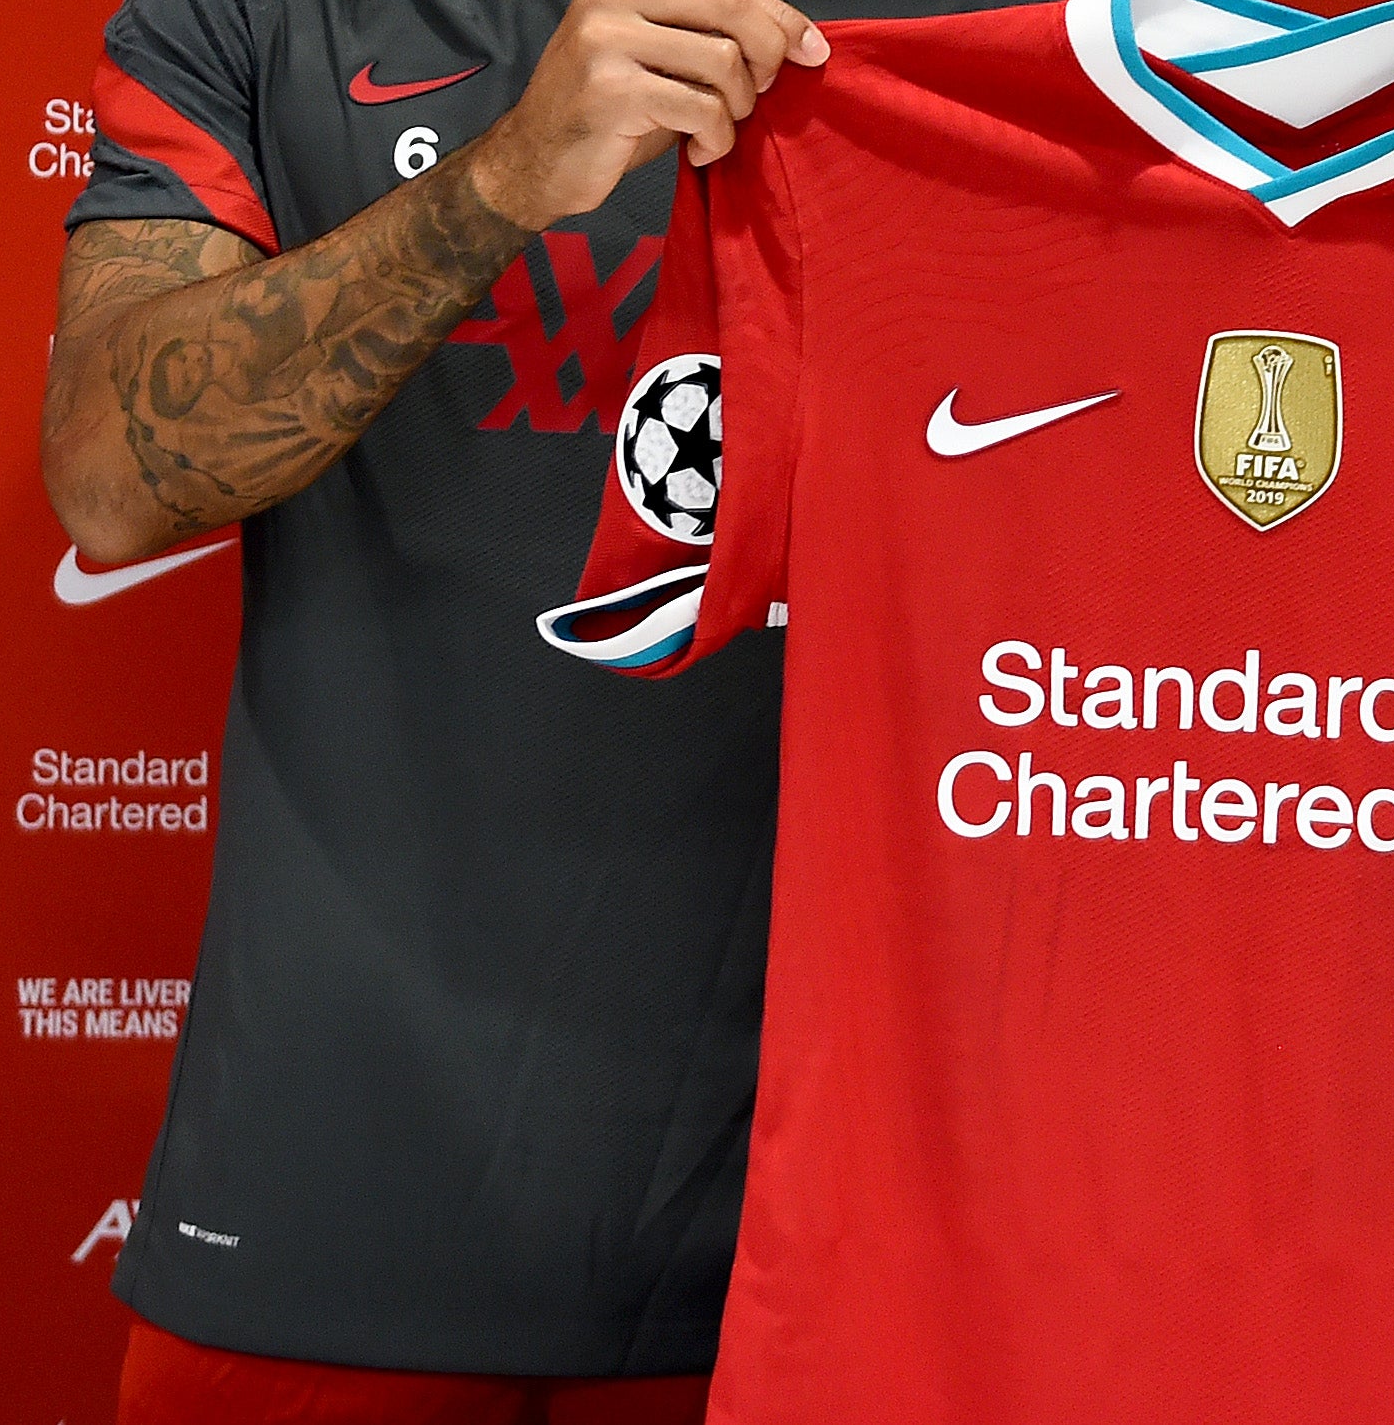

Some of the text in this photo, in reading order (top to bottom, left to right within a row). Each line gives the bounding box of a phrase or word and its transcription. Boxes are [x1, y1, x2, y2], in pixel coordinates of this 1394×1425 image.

[393, 126, 440, 179] 6
[1236, 454, 1299, 480] FIFA
[1246, 489, 1285, 505] 2019
[32, 748, 208, 786] Standard
[16, 793, 207, 831] Chartered
